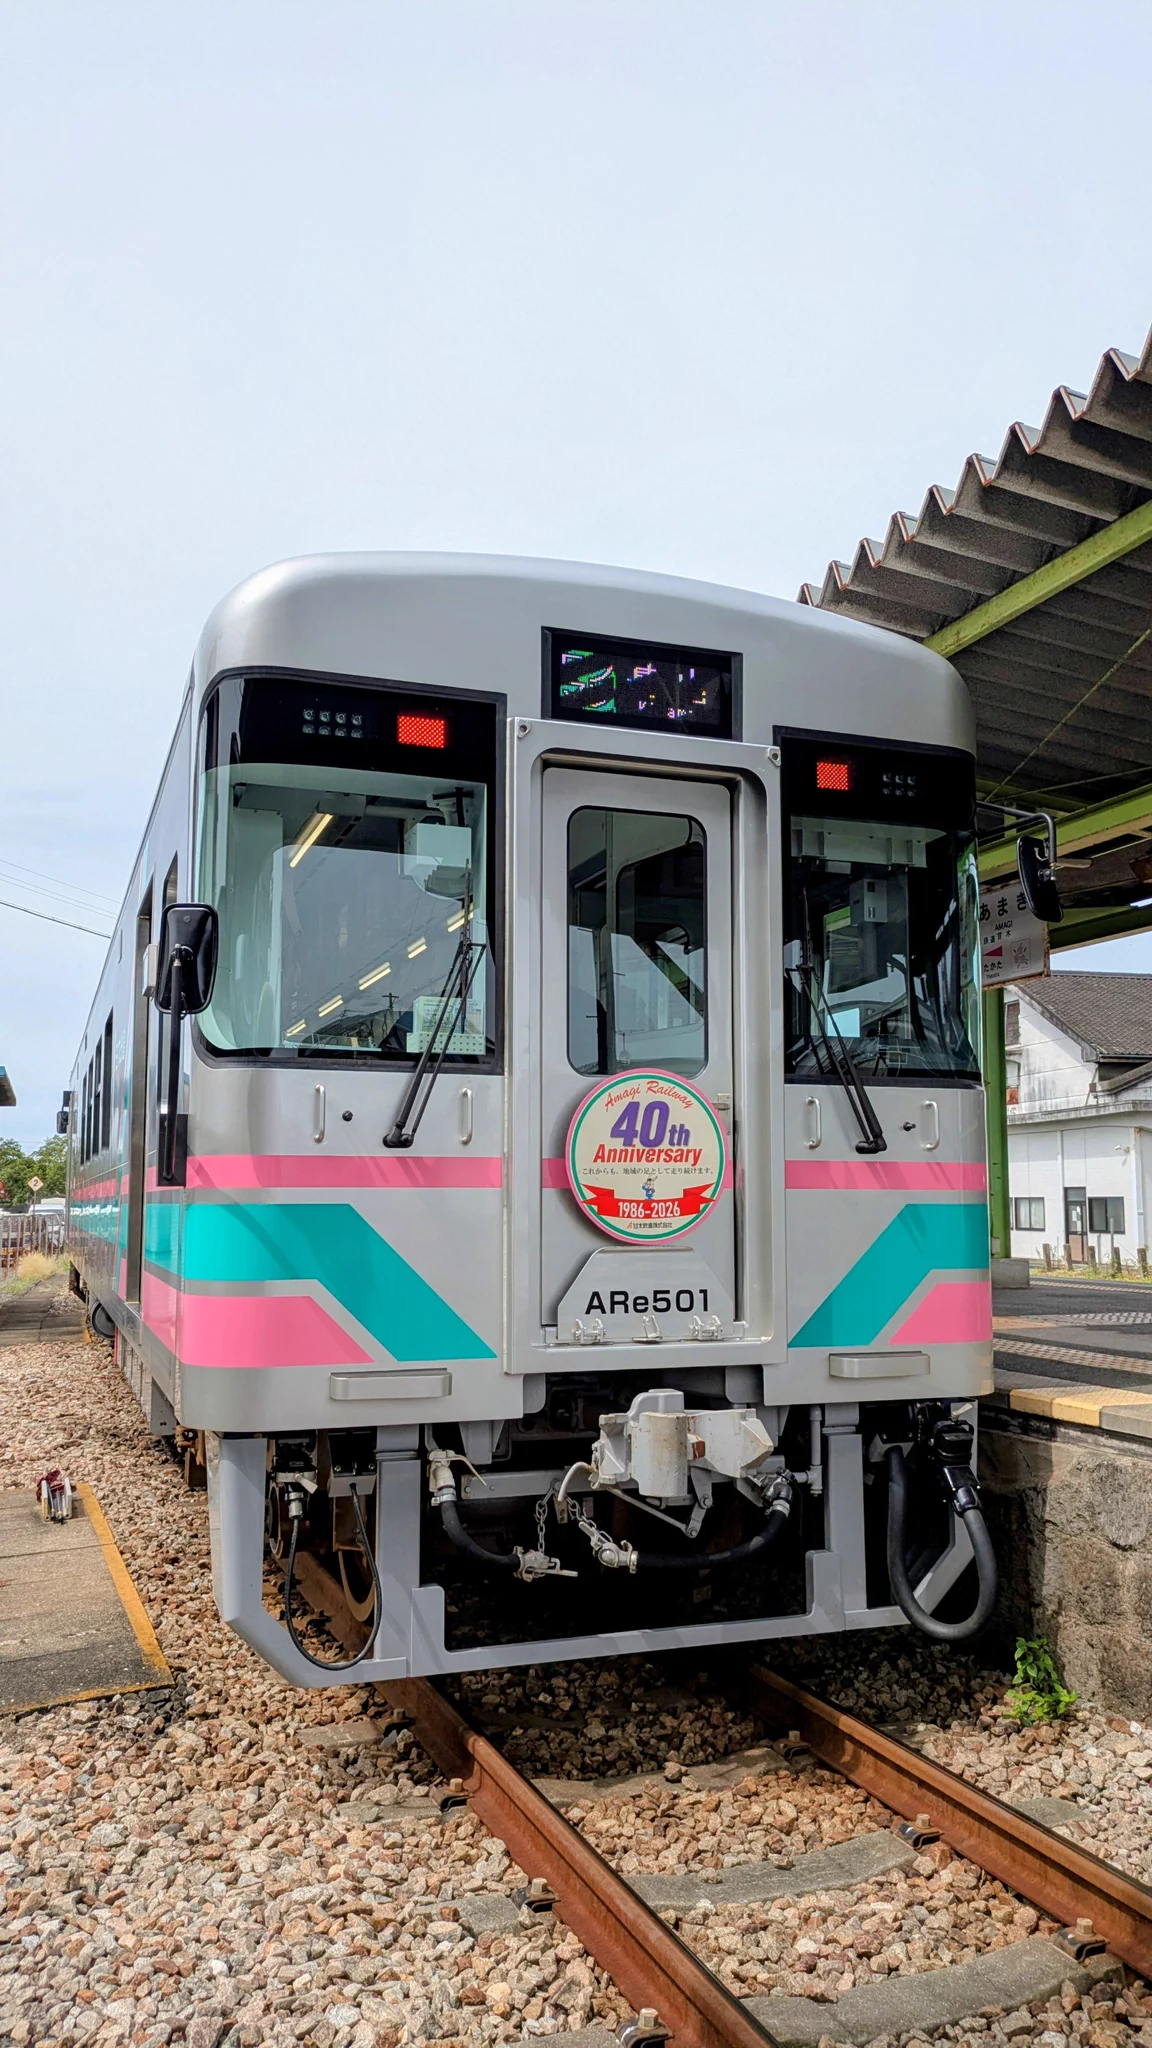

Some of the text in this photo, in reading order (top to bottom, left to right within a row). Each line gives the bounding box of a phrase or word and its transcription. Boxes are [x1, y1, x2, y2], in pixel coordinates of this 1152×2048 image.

[994, 920, 1013, 931] AMAGI
[983, 960, 1003, 972] たかた
[605, 1080, 695, 1112] Amagi Railway
[592, 1143, 703, 1167] Anniversary
[33, 1179, 39, 1187] 2
[618, 1201, 681, 1218] 1986-2026
[585, 1289, 708, 1315] ARe501
